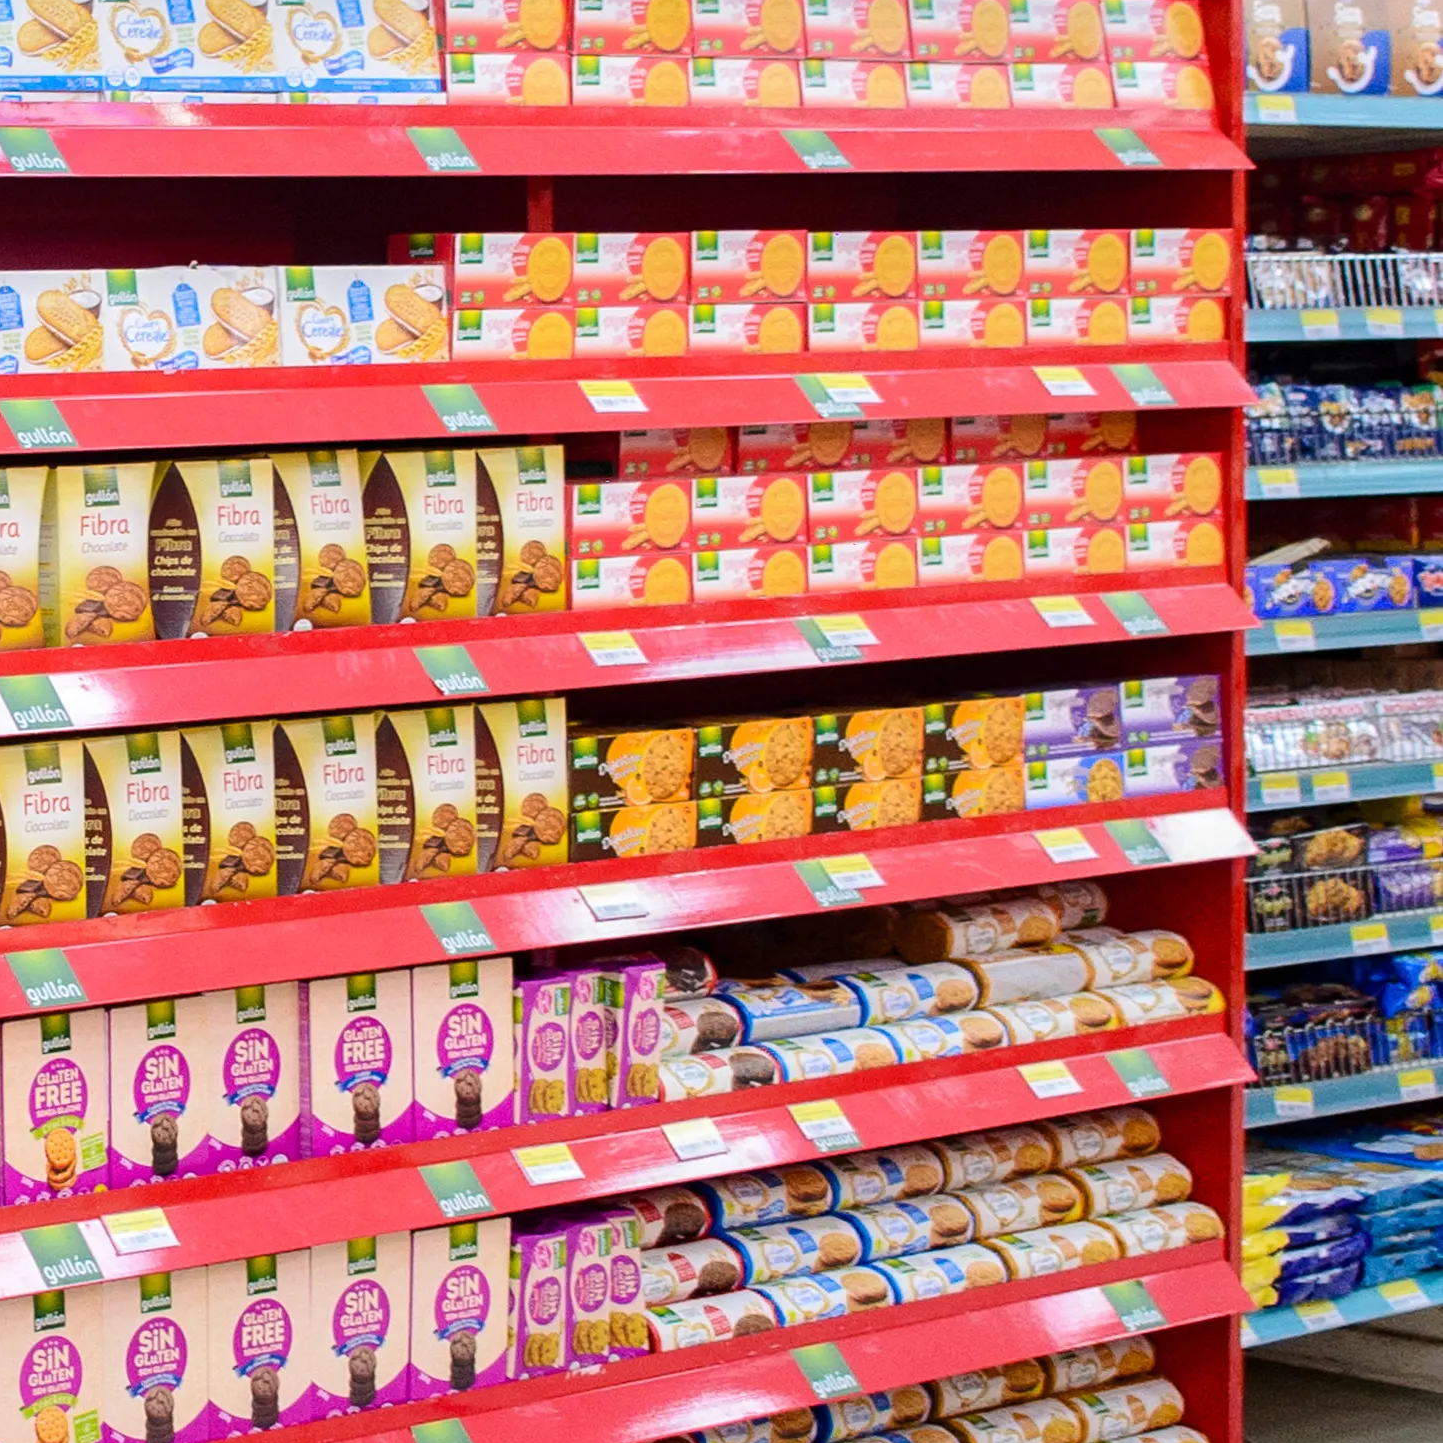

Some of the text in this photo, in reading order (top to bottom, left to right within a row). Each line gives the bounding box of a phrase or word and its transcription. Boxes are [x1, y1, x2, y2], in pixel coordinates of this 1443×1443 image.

[11, 152, 66, 171] gullón
[425, 150, 475, 171] gullón
[217, 505, 260, 526] Fibra
[424, 495, 464, 515] Fibra
[13, 704, 68, 729] gullón
[126, 782, 170, 804] Fibra
[223, 771, 264, 793] Fibra
[23, 793, 71, 815] Fibra
[26, 979, 82, 1006] gullón
[342, 1039, 385, 1063] FREE
[34, 1080, 83, 1110] FREE
[43, 1255, 99, 1285] gullón
[241, 1321, 286, 1345] FREE
